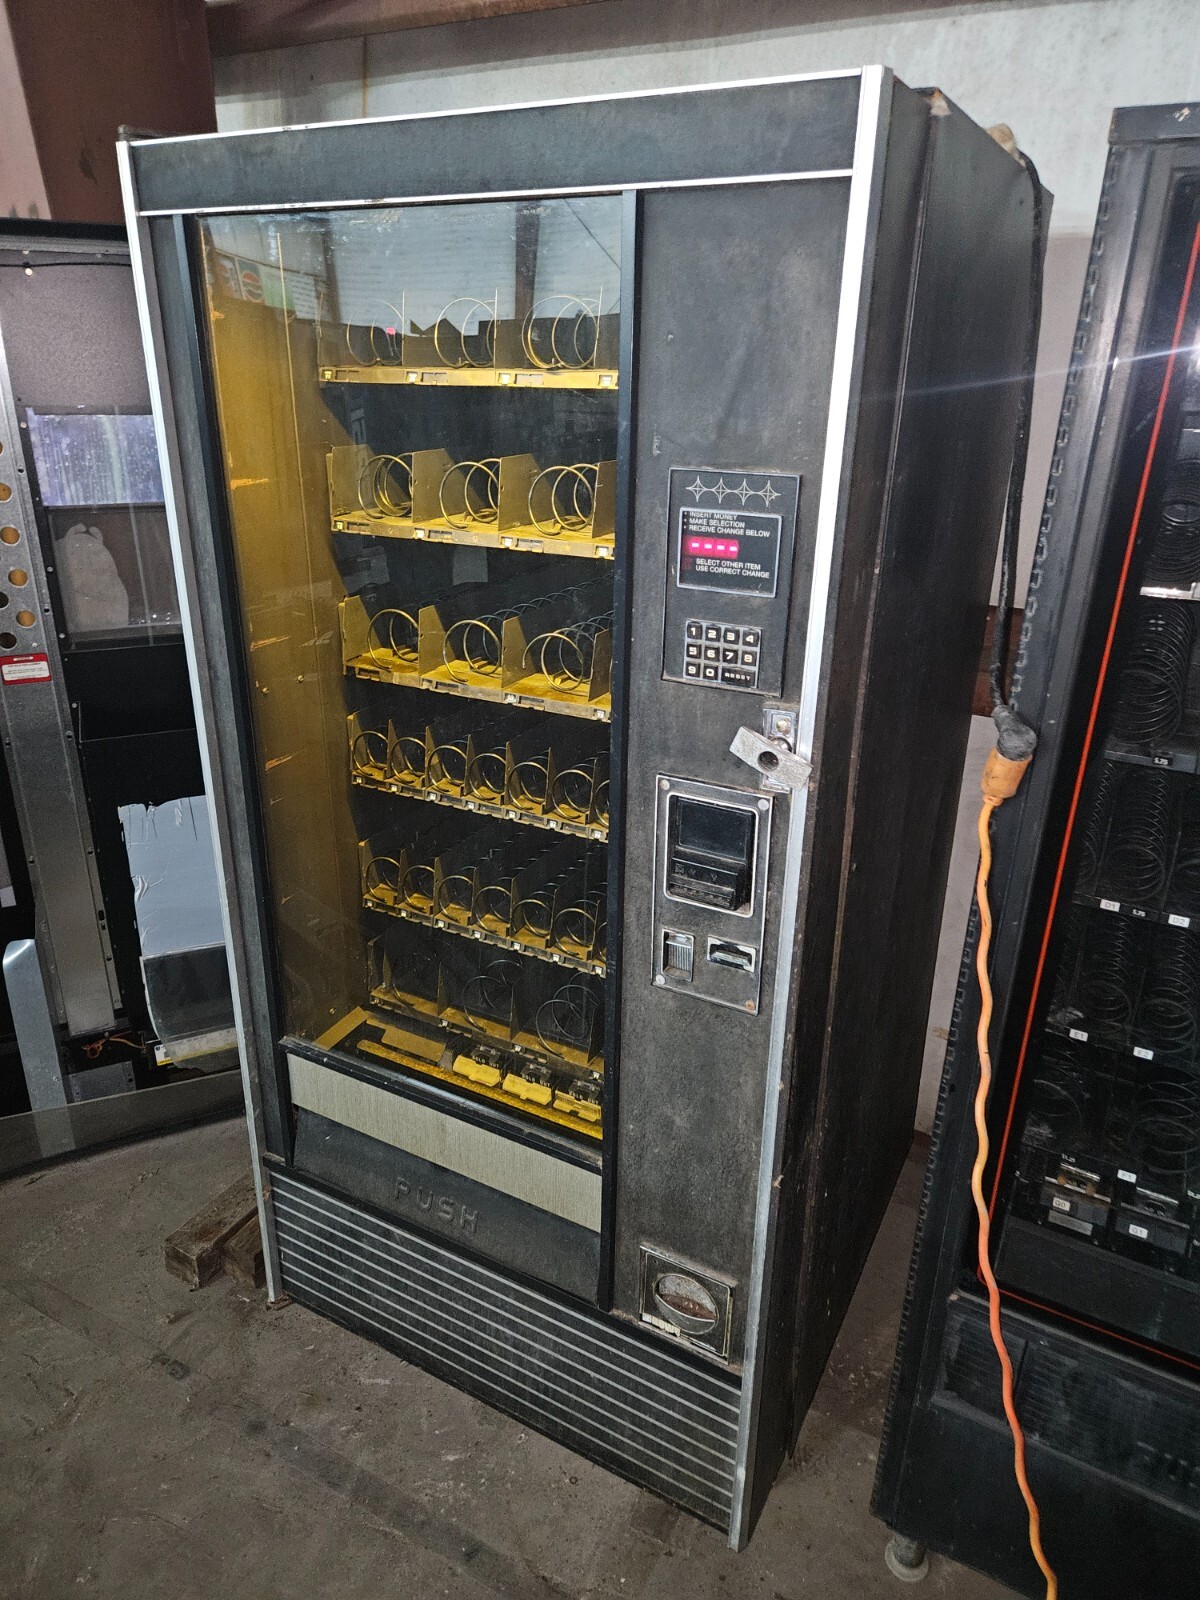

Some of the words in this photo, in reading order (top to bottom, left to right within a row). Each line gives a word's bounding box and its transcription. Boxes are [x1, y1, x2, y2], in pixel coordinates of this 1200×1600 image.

[689, 512, 712, 520] INSERT
[713, 513, 738, 521] MONEY
[689, 518, 708, 526] MAKE
[709, 519, 745, 528] SELECTION
[688, 525, 715, 533] RECEIVE
[717, 527, 744, 536] CHANGE
[745, 529, 770, 537] BELOW
[695, 558, 720, 566] SELECT
[721, 561, 744, 569] OTHER
[744, 562, 761, 570] ITEM
[710, 566, 741, 575] CORRECT
[741, 569, 770, 578] CHANGE
[724, 672, 751, 681] RESET
[394, 1177, 479, 1234] PUSH
